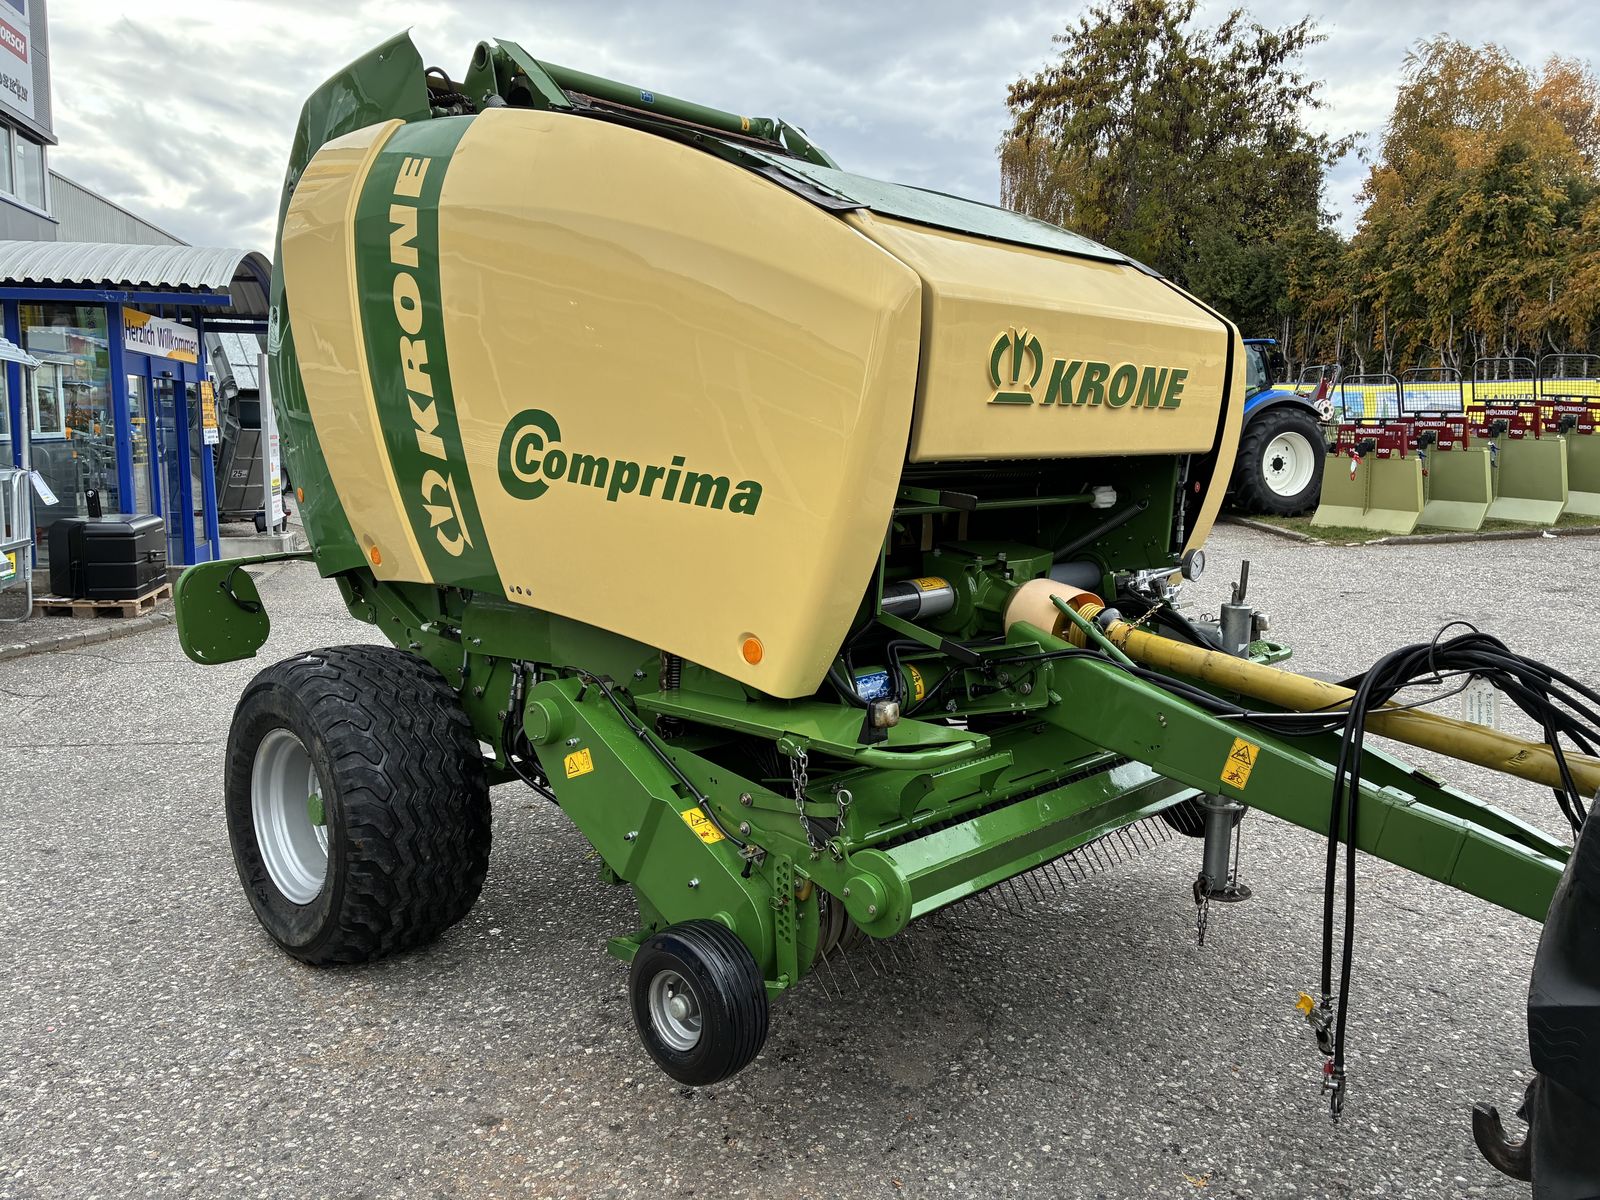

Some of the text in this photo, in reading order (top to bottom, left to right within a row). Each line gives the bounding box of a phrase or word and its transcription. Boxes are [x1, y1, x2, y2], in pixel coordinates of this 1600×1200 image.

[0, 25, 25, 54] ORSCH
[389, 157, 447, 460] KRONE
[125, 317, 198, 355] Herzlich Willkommen
[1040, 357, 1189, 408] KRONE
[232, 470, 243, 478] 25
[497, 408, 763, 516] Comprima
